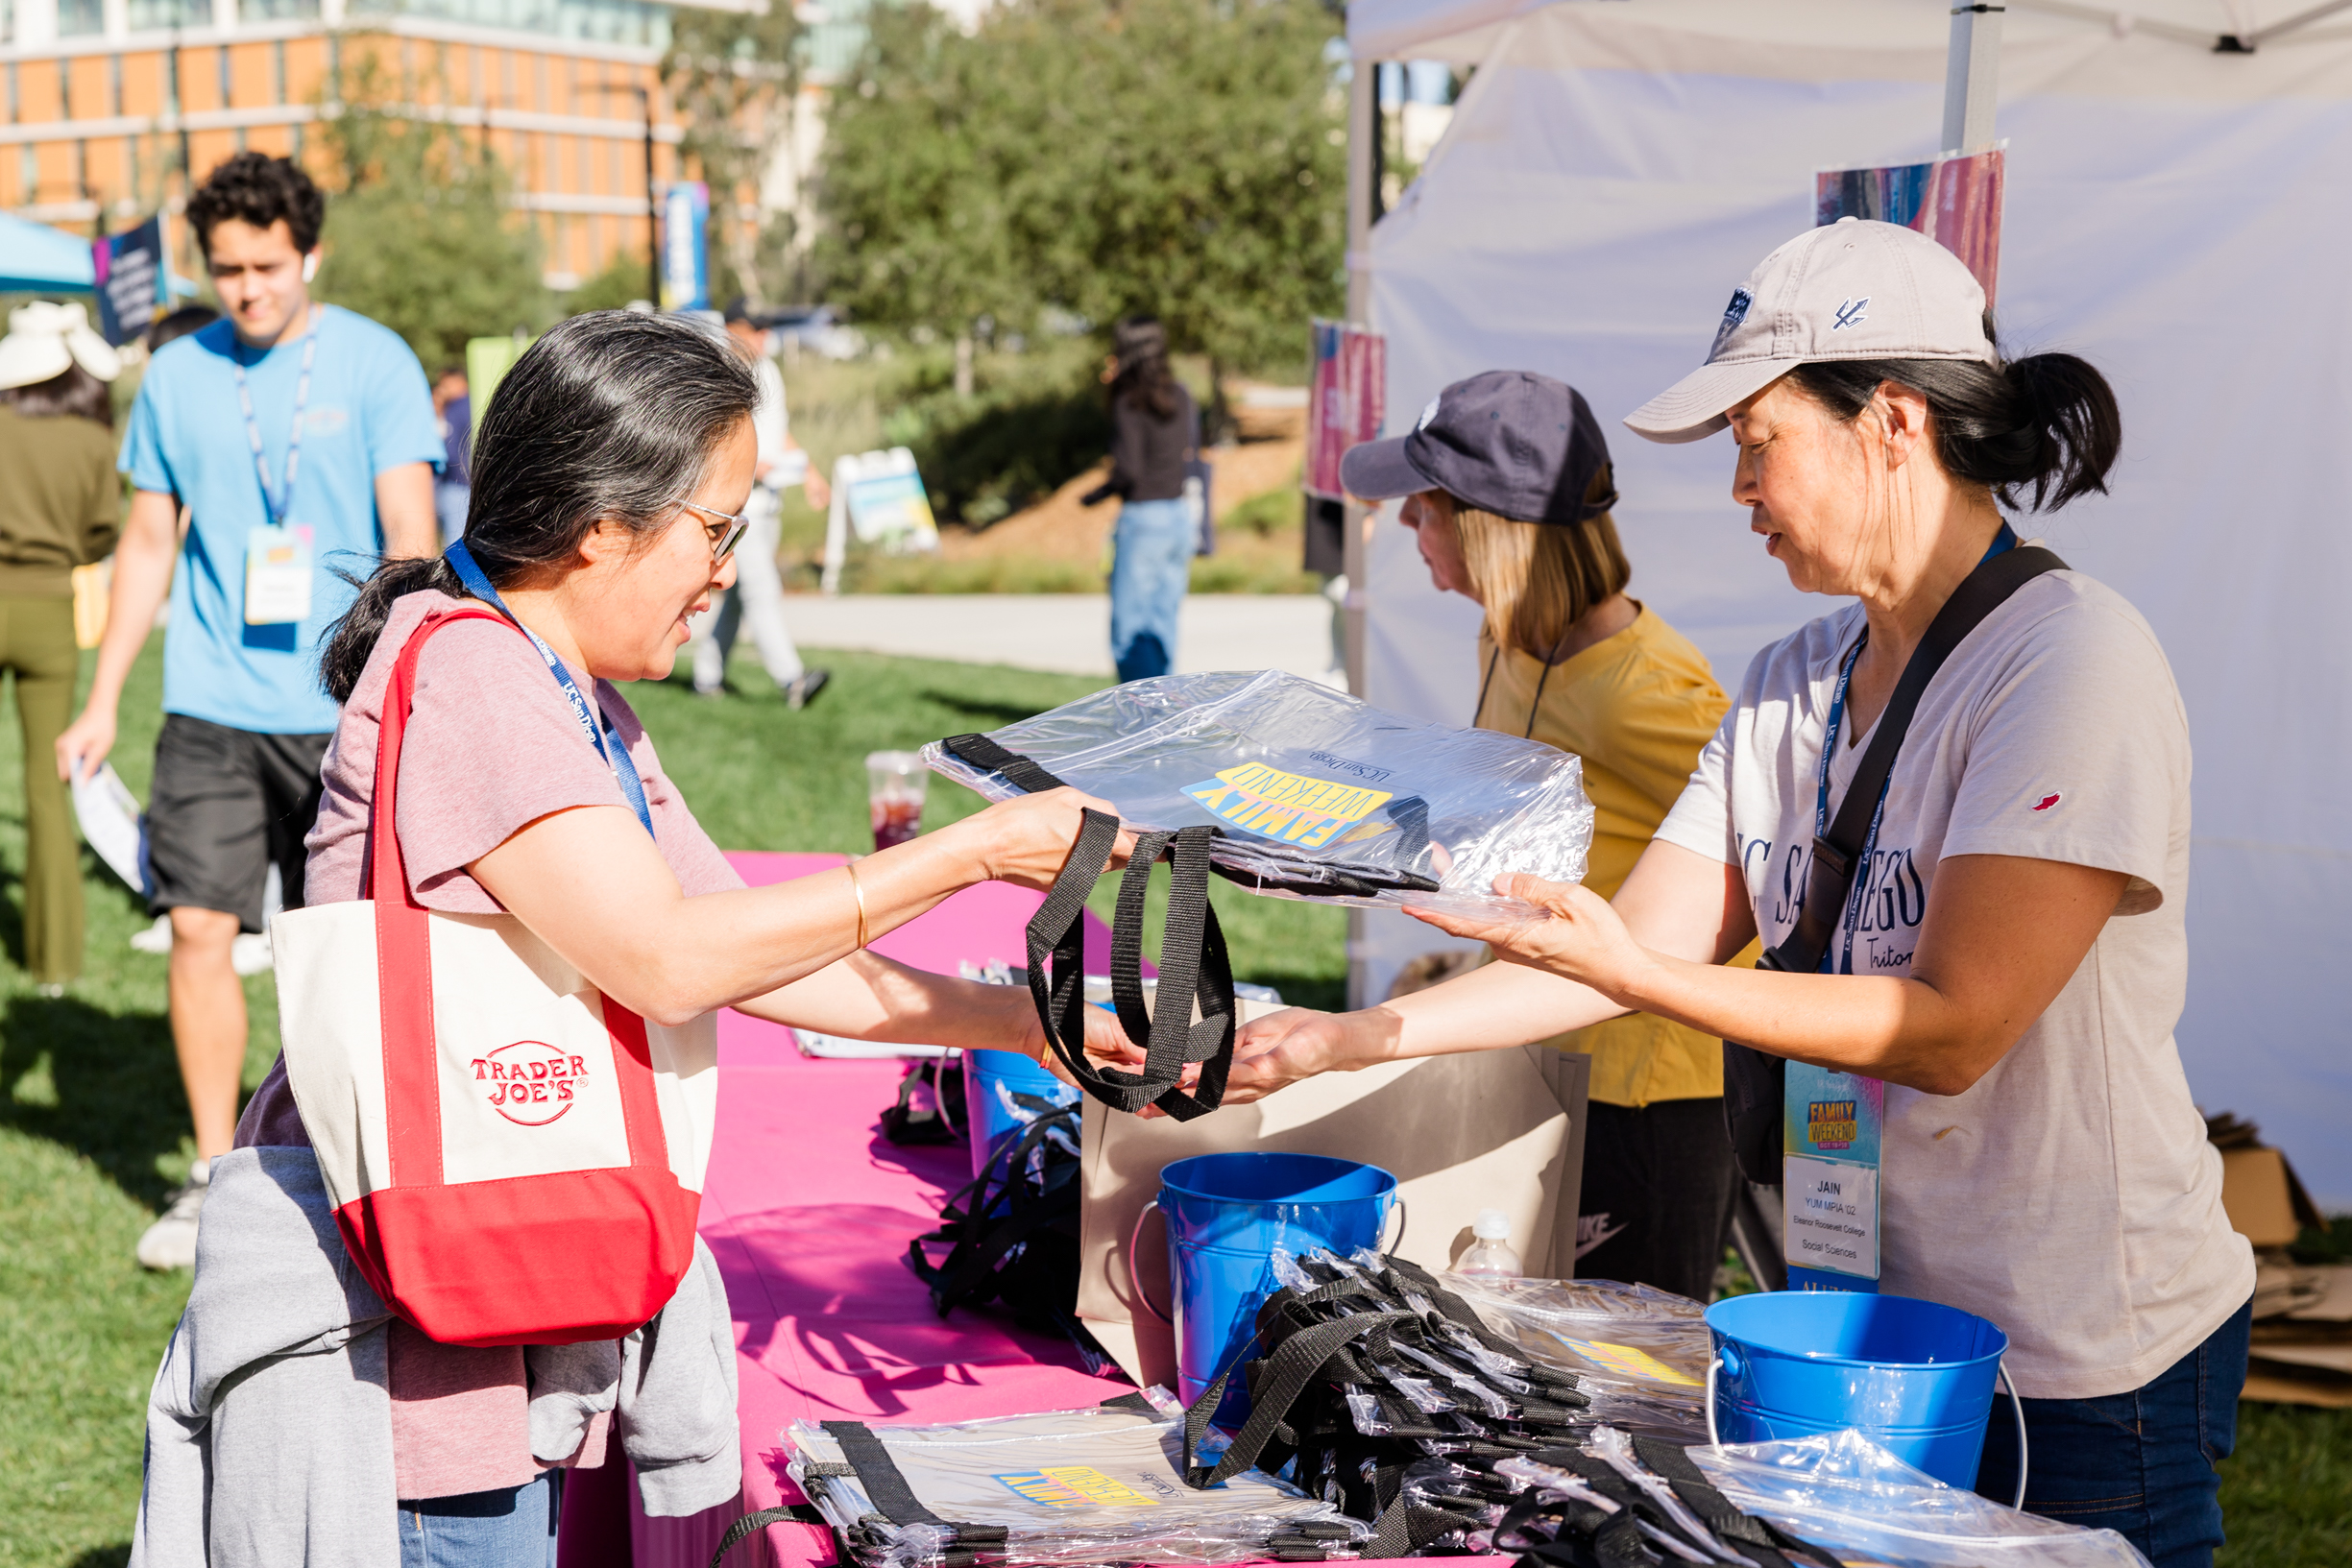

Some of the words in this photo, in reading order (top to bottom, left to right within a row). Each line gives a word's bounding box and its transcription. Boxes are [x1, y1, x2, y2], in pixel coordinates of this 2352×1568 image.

[563, 681, 579, 700] UC
[1833, 676, 1848, 704] Diego
[570, 696, 585, 719] San
[580, 717, 596, 743] Diego
[1827, 724, 1836, 739] UC
[1308, 751, 1346, 770] Diego
[1343, 762, 1371, 777] San
[1362, 769, 1391, 783] UC
[1232, 766, 1374, 816] WEEKEND
[1192, 784, 1348, 848] FAMILY
[1816, 808, 1825, 825] UC
[1867, 829, 1876, 846] San
[1863, 847, 1873, 864] UC
[1775, 844, 1814, 925] SA
[1844, 933, 1852, 952] UC
[470, 1055, 590, 1081] TRADER
[487, 1079, 574, 1106] JOE'S
[1809, 1102, 1855, 1123] FAMILY
[1810, 1122, 1855, 1141] WEEKEND
[1817, 1180, 1841, 1195] JAIN
[1806, 1196, 1823, 1209] YUM
[1825, 1201, 1843, 1214] MPIA
[1844, 1204, 1856, 1216] '02
[1577, 1213, 1610, 1242] IKE
[1793, 1215, 1814, 1226] Eleanor
[1814, 1219, 1842, 1232] Roosevelt
[1844, 1224, 1866, 1238] College
[1802, 1239, 1823, 1252] Social
[1825, 1243, 1857, 1259] Sciences
